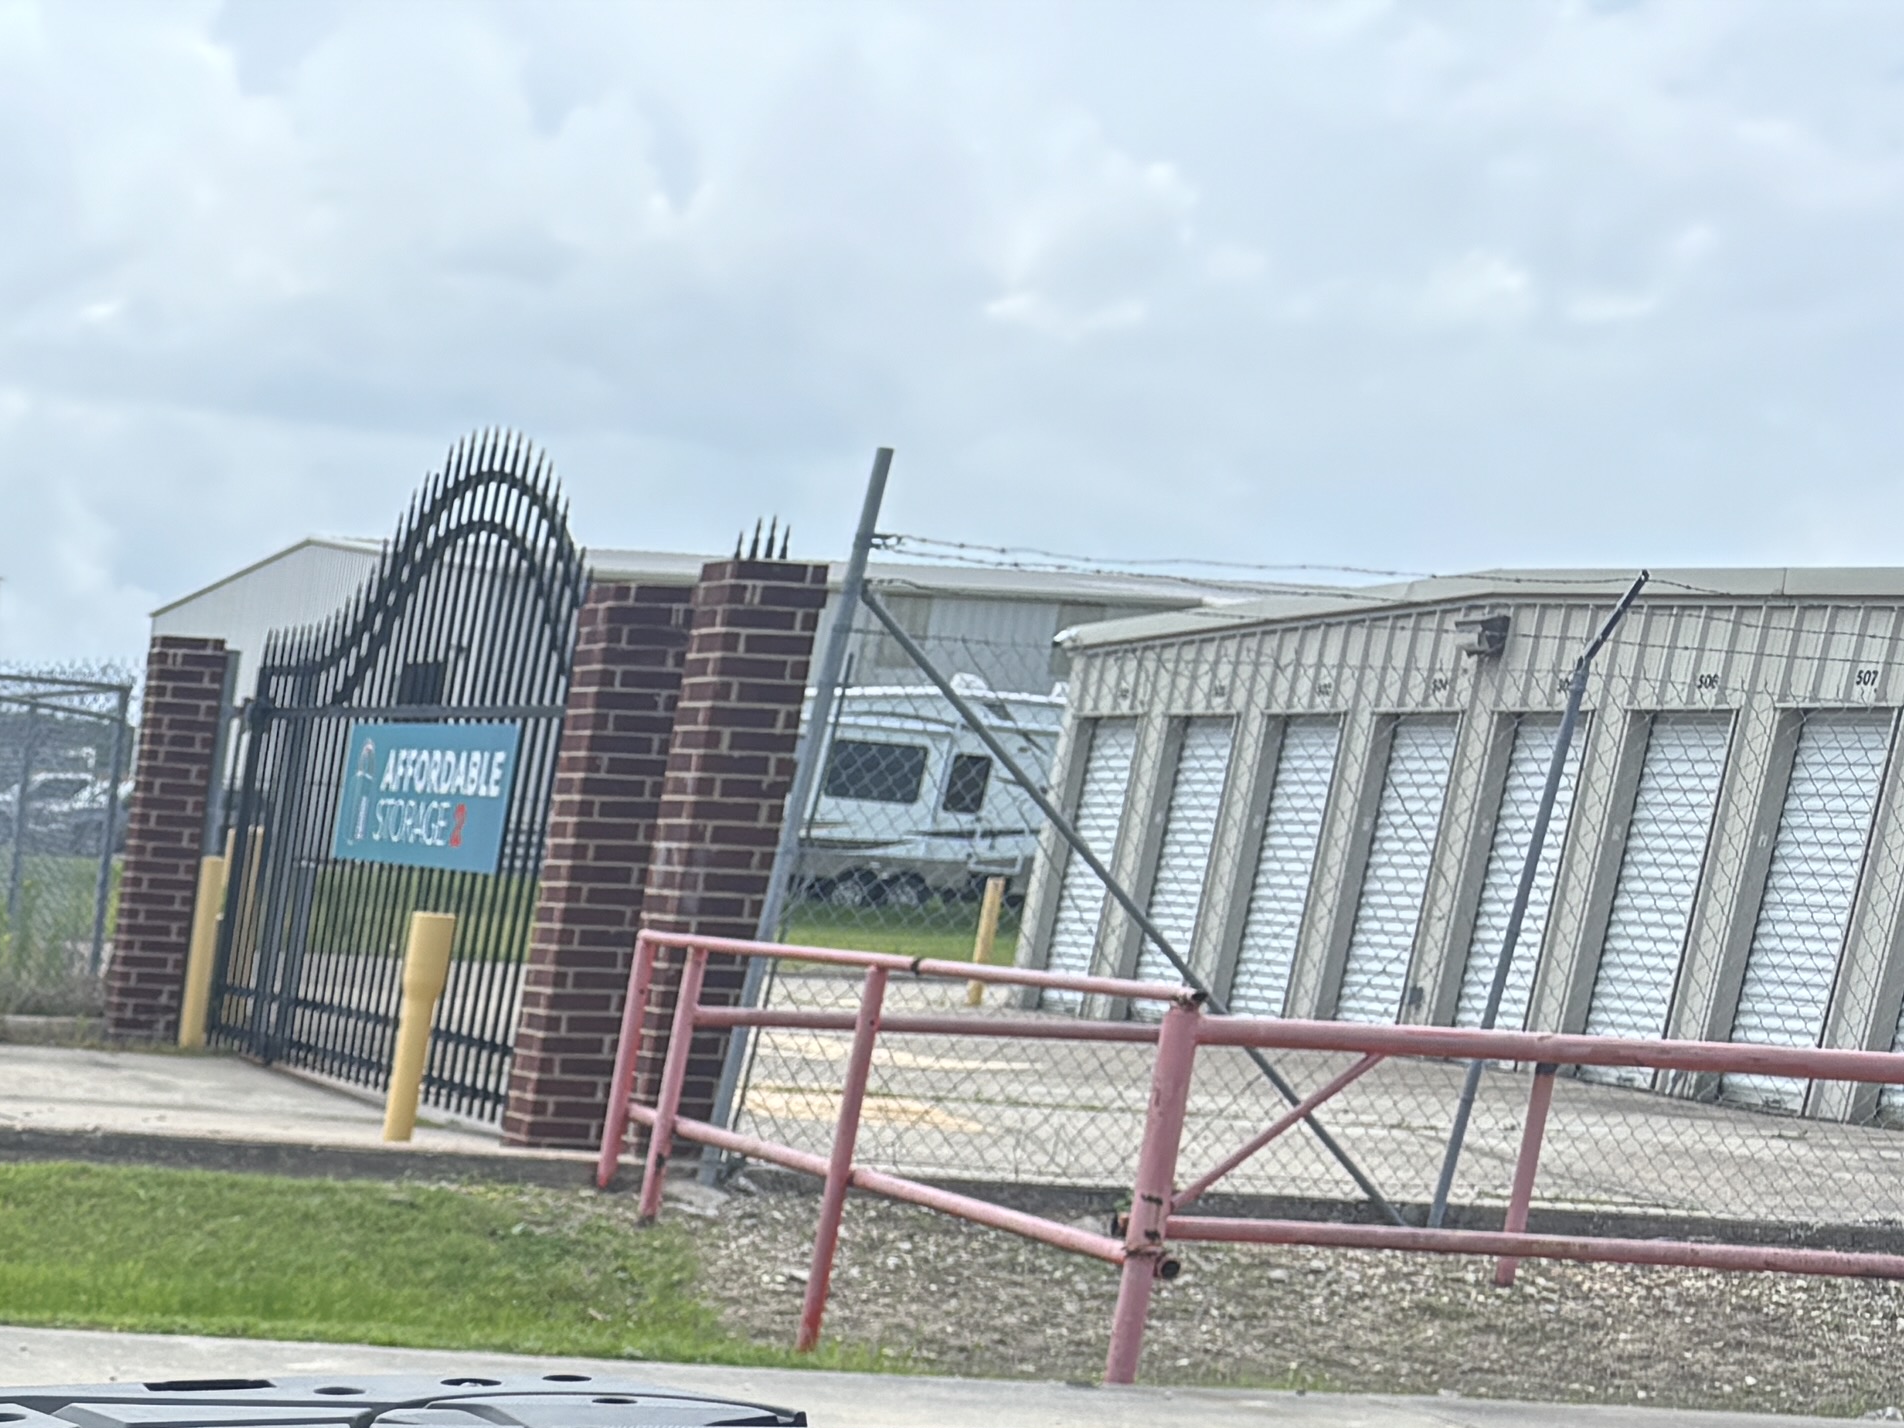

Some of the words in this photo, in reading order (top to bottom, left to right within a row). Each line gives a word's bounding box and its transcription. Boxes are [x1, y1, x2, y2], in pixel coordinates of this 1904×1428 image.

[1856, 670, 1879, 686] 507
[380, 748, 506, 797] AFFORDABLE
[372, 798, 451, 846] STORAGE
